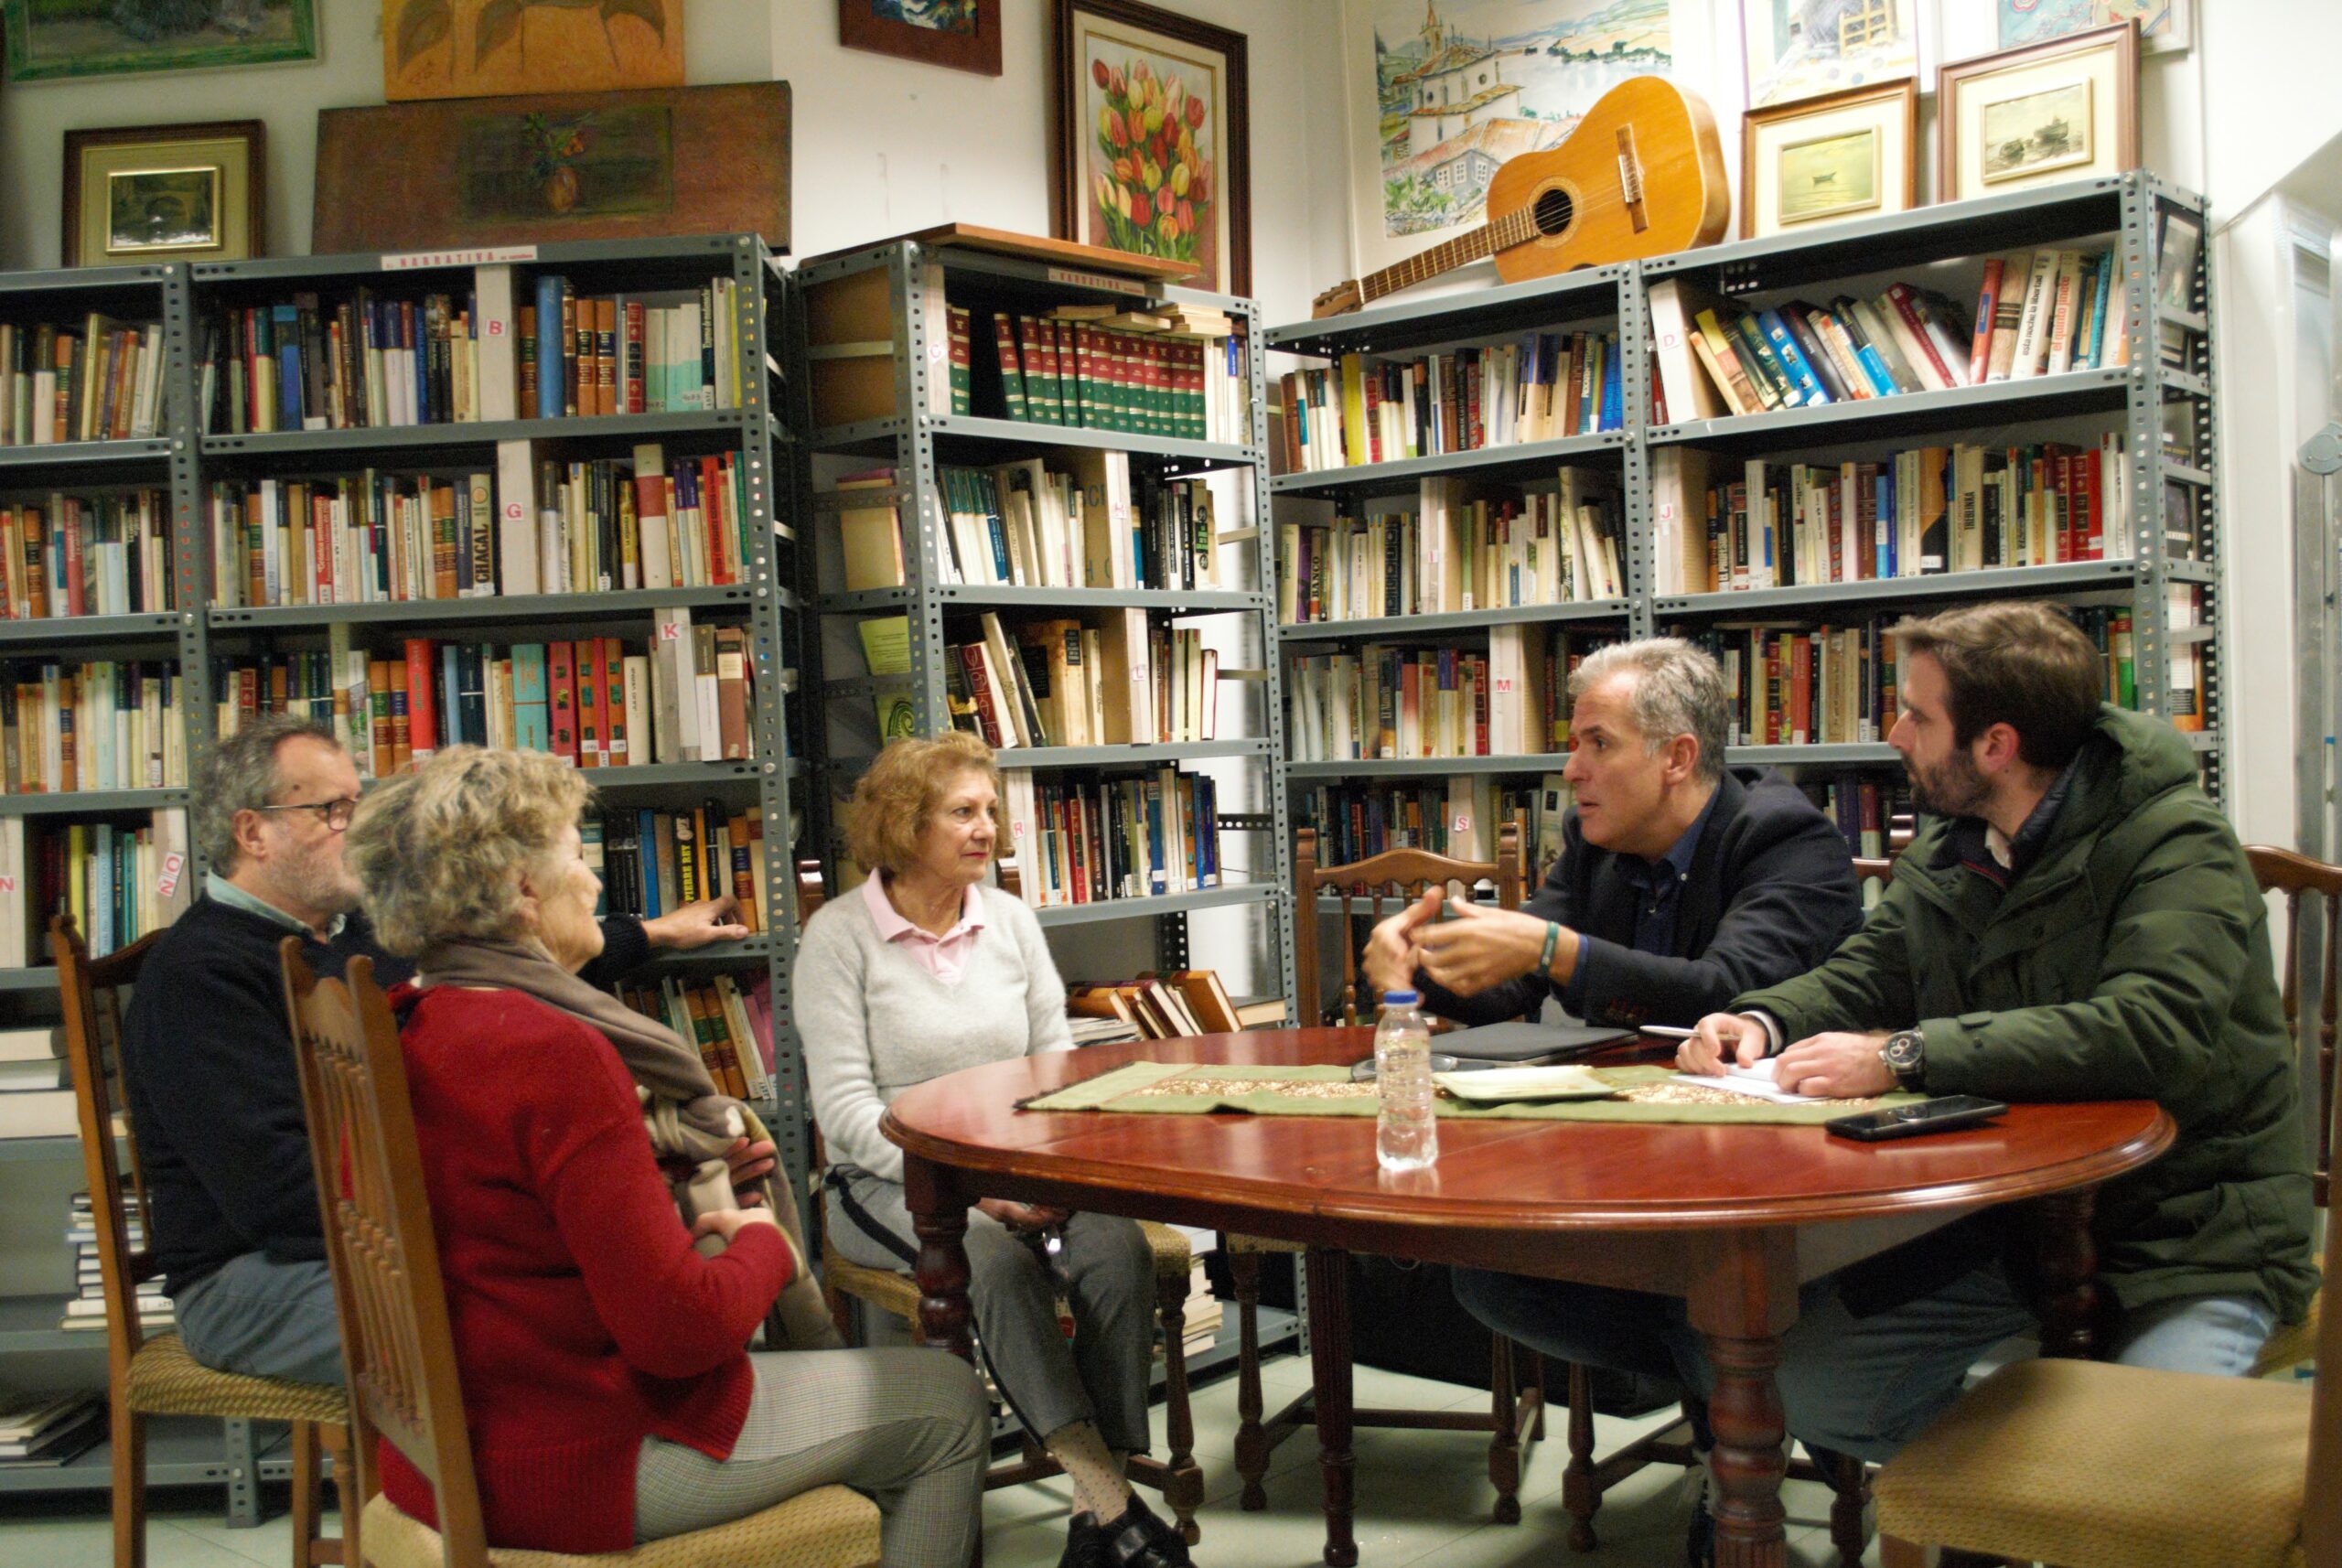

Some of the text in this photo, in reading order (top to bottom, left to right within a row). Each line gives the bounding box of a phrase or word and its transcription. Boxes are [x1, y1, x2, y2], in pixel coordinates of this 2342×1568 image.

[400, 251, 495, 269] NARRATIVA
[2030, 275, 2043, 304] libertad
[2051, 276, 2069, 351] el quinto jinete
[489, 321, 502, 335] B
[2026, 315, 2036, 338] noche
[1663, 334, 1675, 347] D
[2022, 339, 2033, 356] esta
[930, 344, 941, 358] C
[506, 503, 521, 519] G
[1662, 506, 1671, 520] J
[1964, 492, 1975, 531] TREBLINKA
[474, 524, 490, 584] CHACAL
[1312, 556, 1320, 598] BANCO
[663, 623, 678, 638] K
[1135, 666, 1144, 679] L
[1498, 680, 1510, 691] M
[1015, 822, 1024, 836] R
[1457, 817, 1467, 830] S
[681, 845, 693, 901] PIERRE REY
